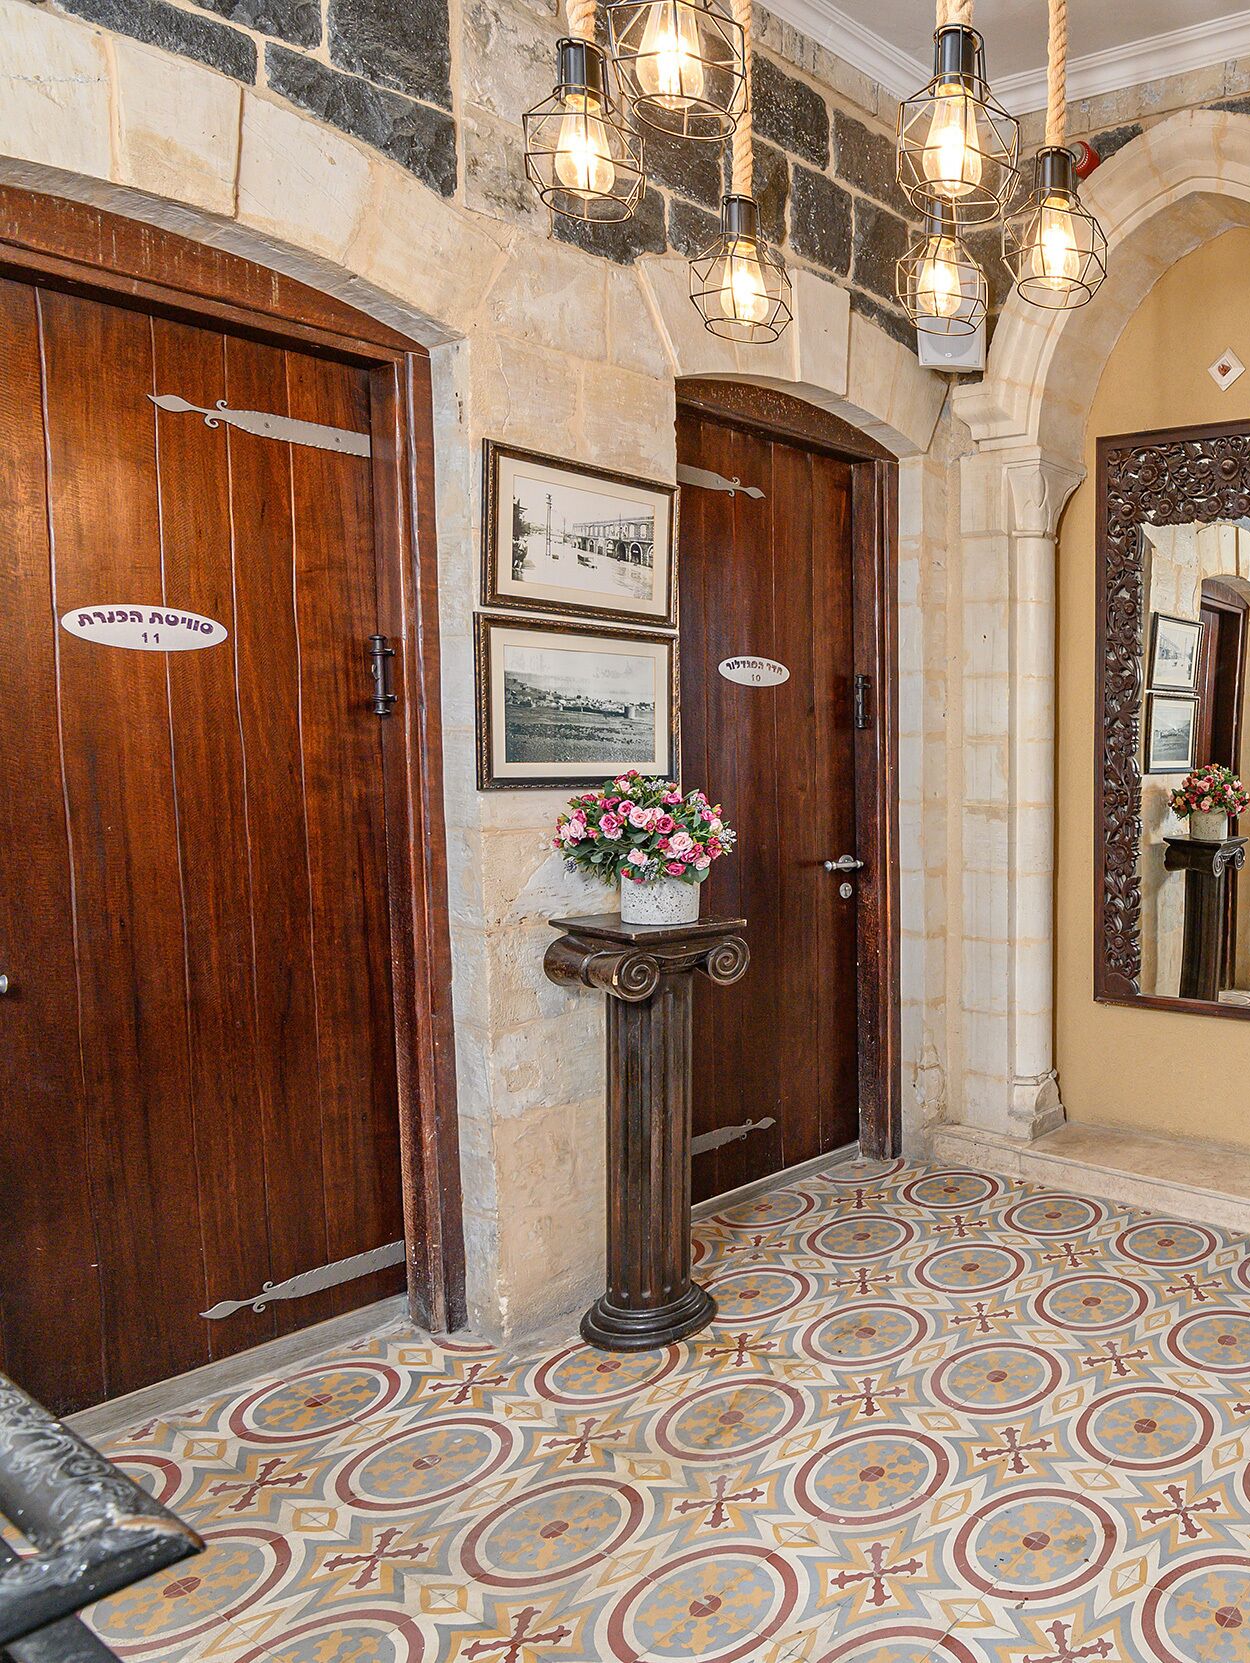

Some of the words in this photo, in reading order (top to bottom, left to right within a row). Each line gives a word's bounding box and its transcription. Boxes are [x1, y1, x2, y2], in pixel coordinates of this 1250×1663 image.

[77, 610, 144, 627] הכנרת
[149, 612, 214, 635] סוויטת
[141, 632, 160, 644] 11
[766, 662, 783, 675] חדר
[751, 674, 761, 682] 10
